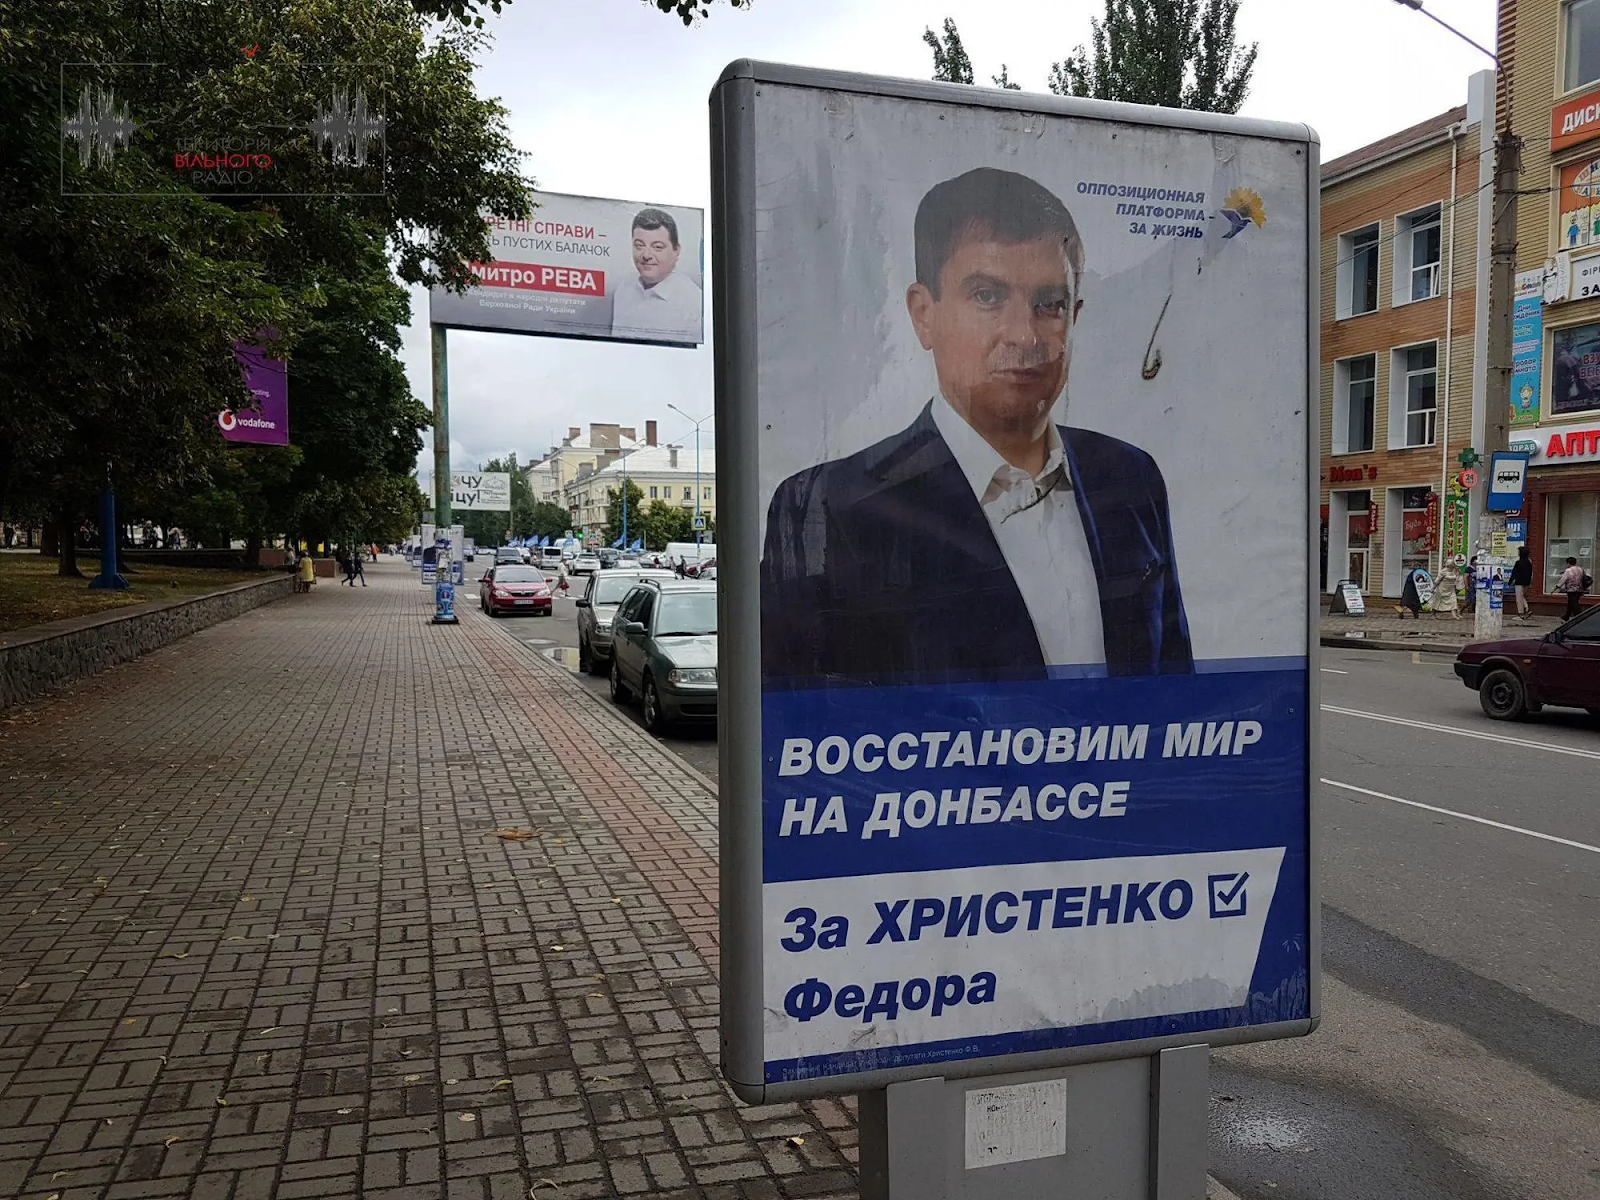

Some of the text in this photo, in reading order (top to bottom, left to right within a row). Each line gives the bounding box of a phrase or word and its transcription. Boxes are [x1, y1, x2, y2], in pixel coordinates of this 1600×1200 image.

[1076, 182, 1205, 204] ОППОЗИЦИОННАЯ
[1115, 203, 1206, 221] ПЛАТФОРМА
[483, 215, 530, 233] РЕТНІ
[534, 221, 594, 240] СПРАВИ
[1129, 222, 1204, 239] ЗА ЖИЗНЬ
[503, 236, 553, 252] ПУСТИХ
[555, 241, 610, 257] БАЛАЧОК
[471, 265, 597, 291] митро РЕВА
[237, 418, 276, 429] vodafone
[778, 720, 1264, 777] ВОССТАНОВИМ МИР
[778, 781, 1131, 840] НА ДОНБАССЕ
[780, 879, 1194, 953] За ХРИСТЕНКО
[783, 969, 998, 1023] Федора
[927, 1047, 964, 1059] Христенко
